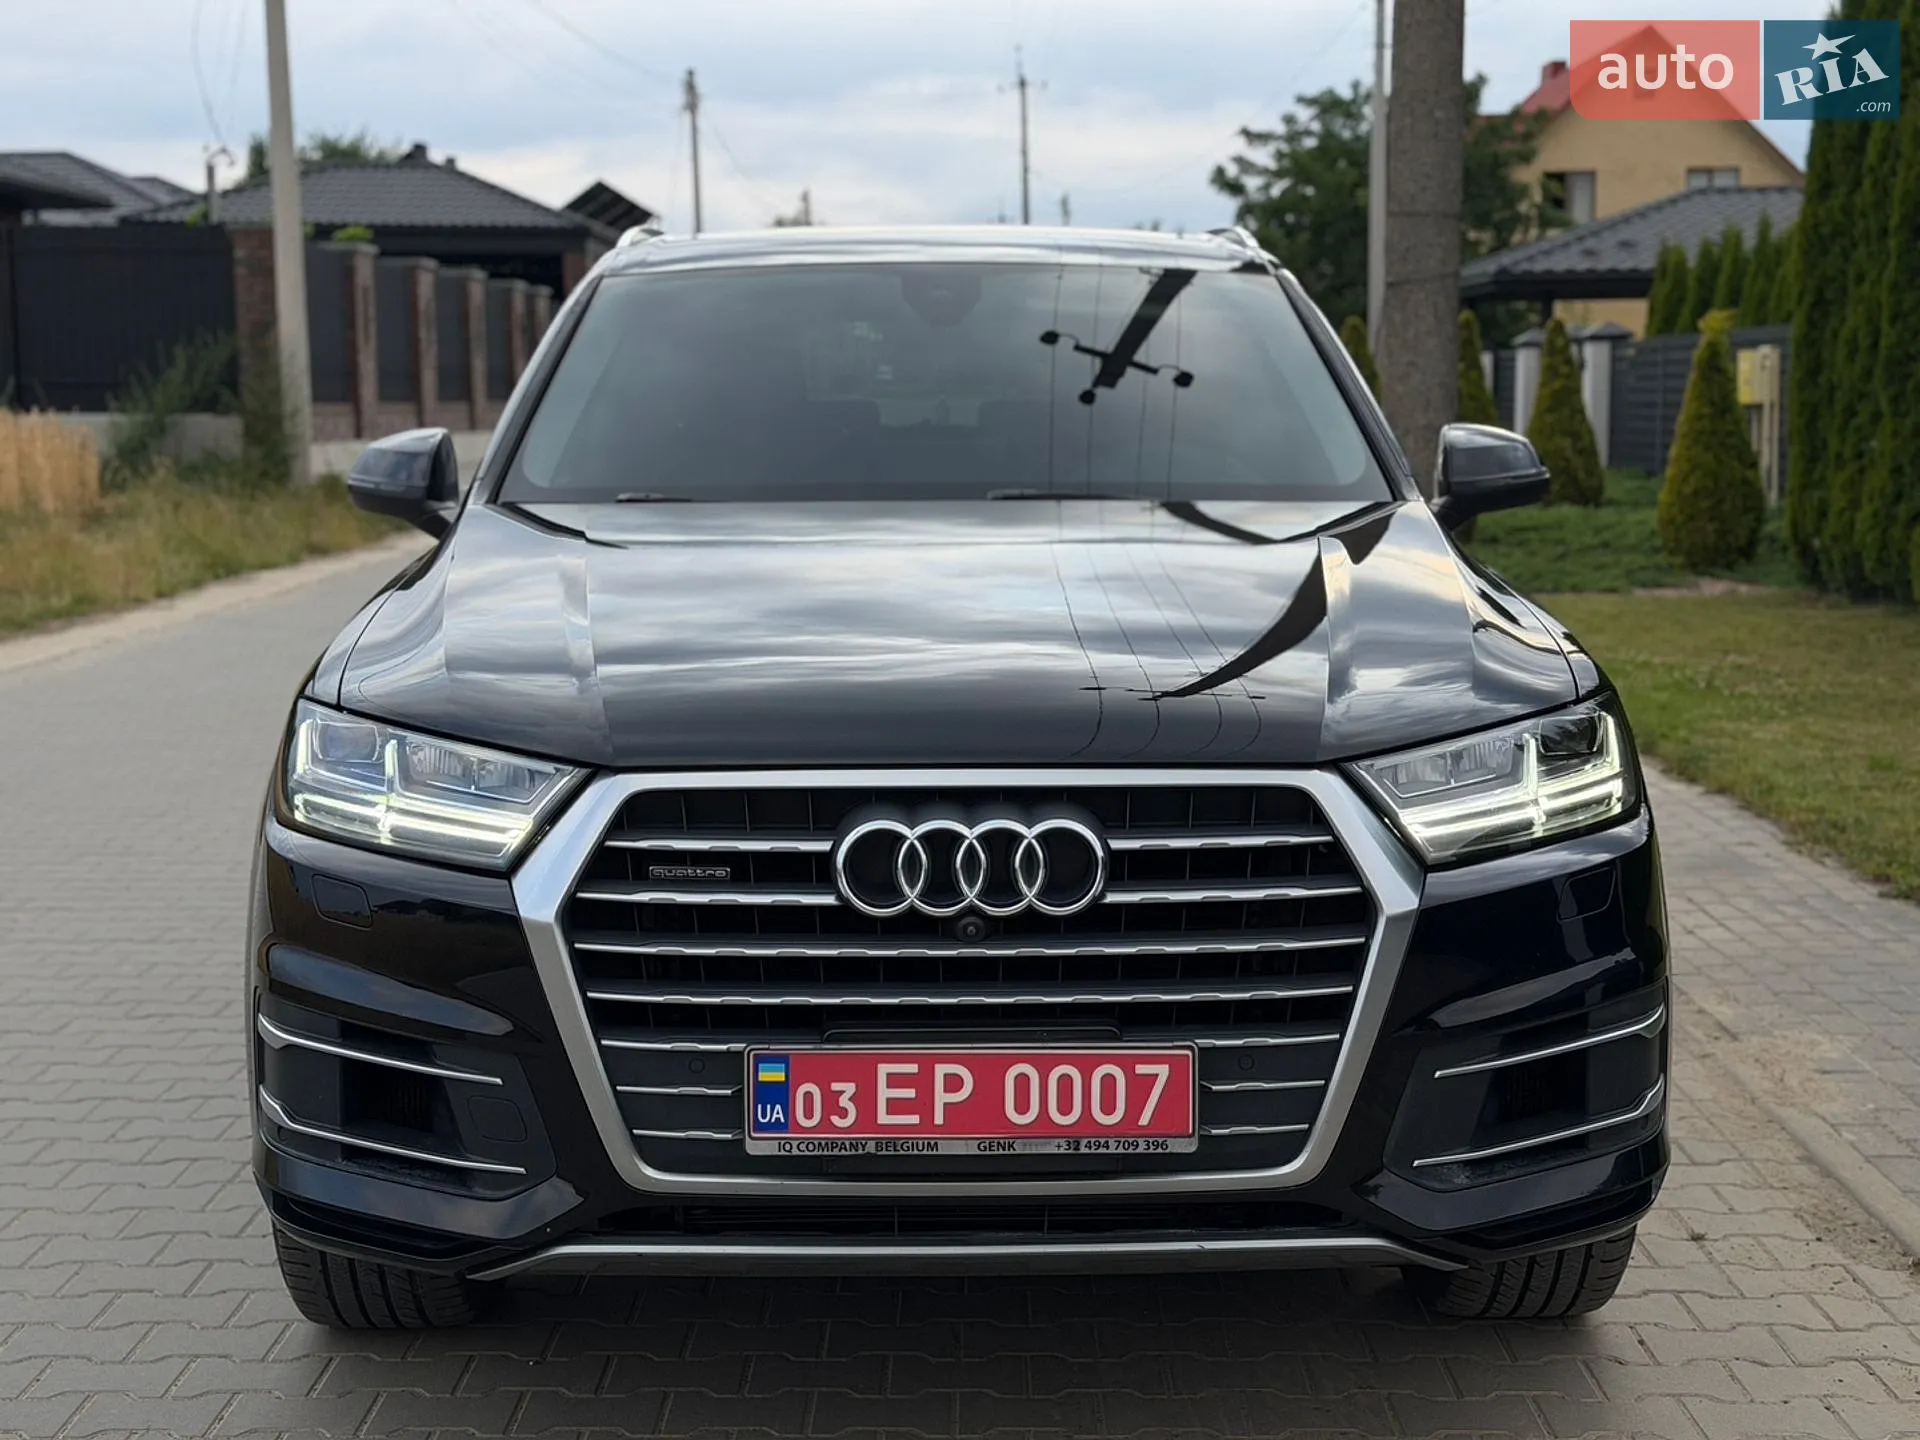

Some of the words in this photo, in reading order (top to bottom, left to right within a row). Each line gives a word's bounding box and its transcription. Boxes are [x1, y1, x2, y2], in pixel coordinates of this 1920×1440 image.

[653, 868, 727, 879] quattro
[795, 1082, 858, 1128] 03
[877, 1063, 975, 1126] EP
[1004, 1063, 1170, 1127] 0007
[757, 1104, 785, 1123] UA
[778, 1141, 793, 1154] IQ
[797, 1141, 868, 1153] COMPANY
[875, 1141, 939, 1153] BELGIUM
[977, 1140, 1017, 1152] GENK
[1084, 1139, 1110, 1151] 494
[1115, 1139, 1140, 1151] 709
[1143, 1138, 1169, 1151] 396
